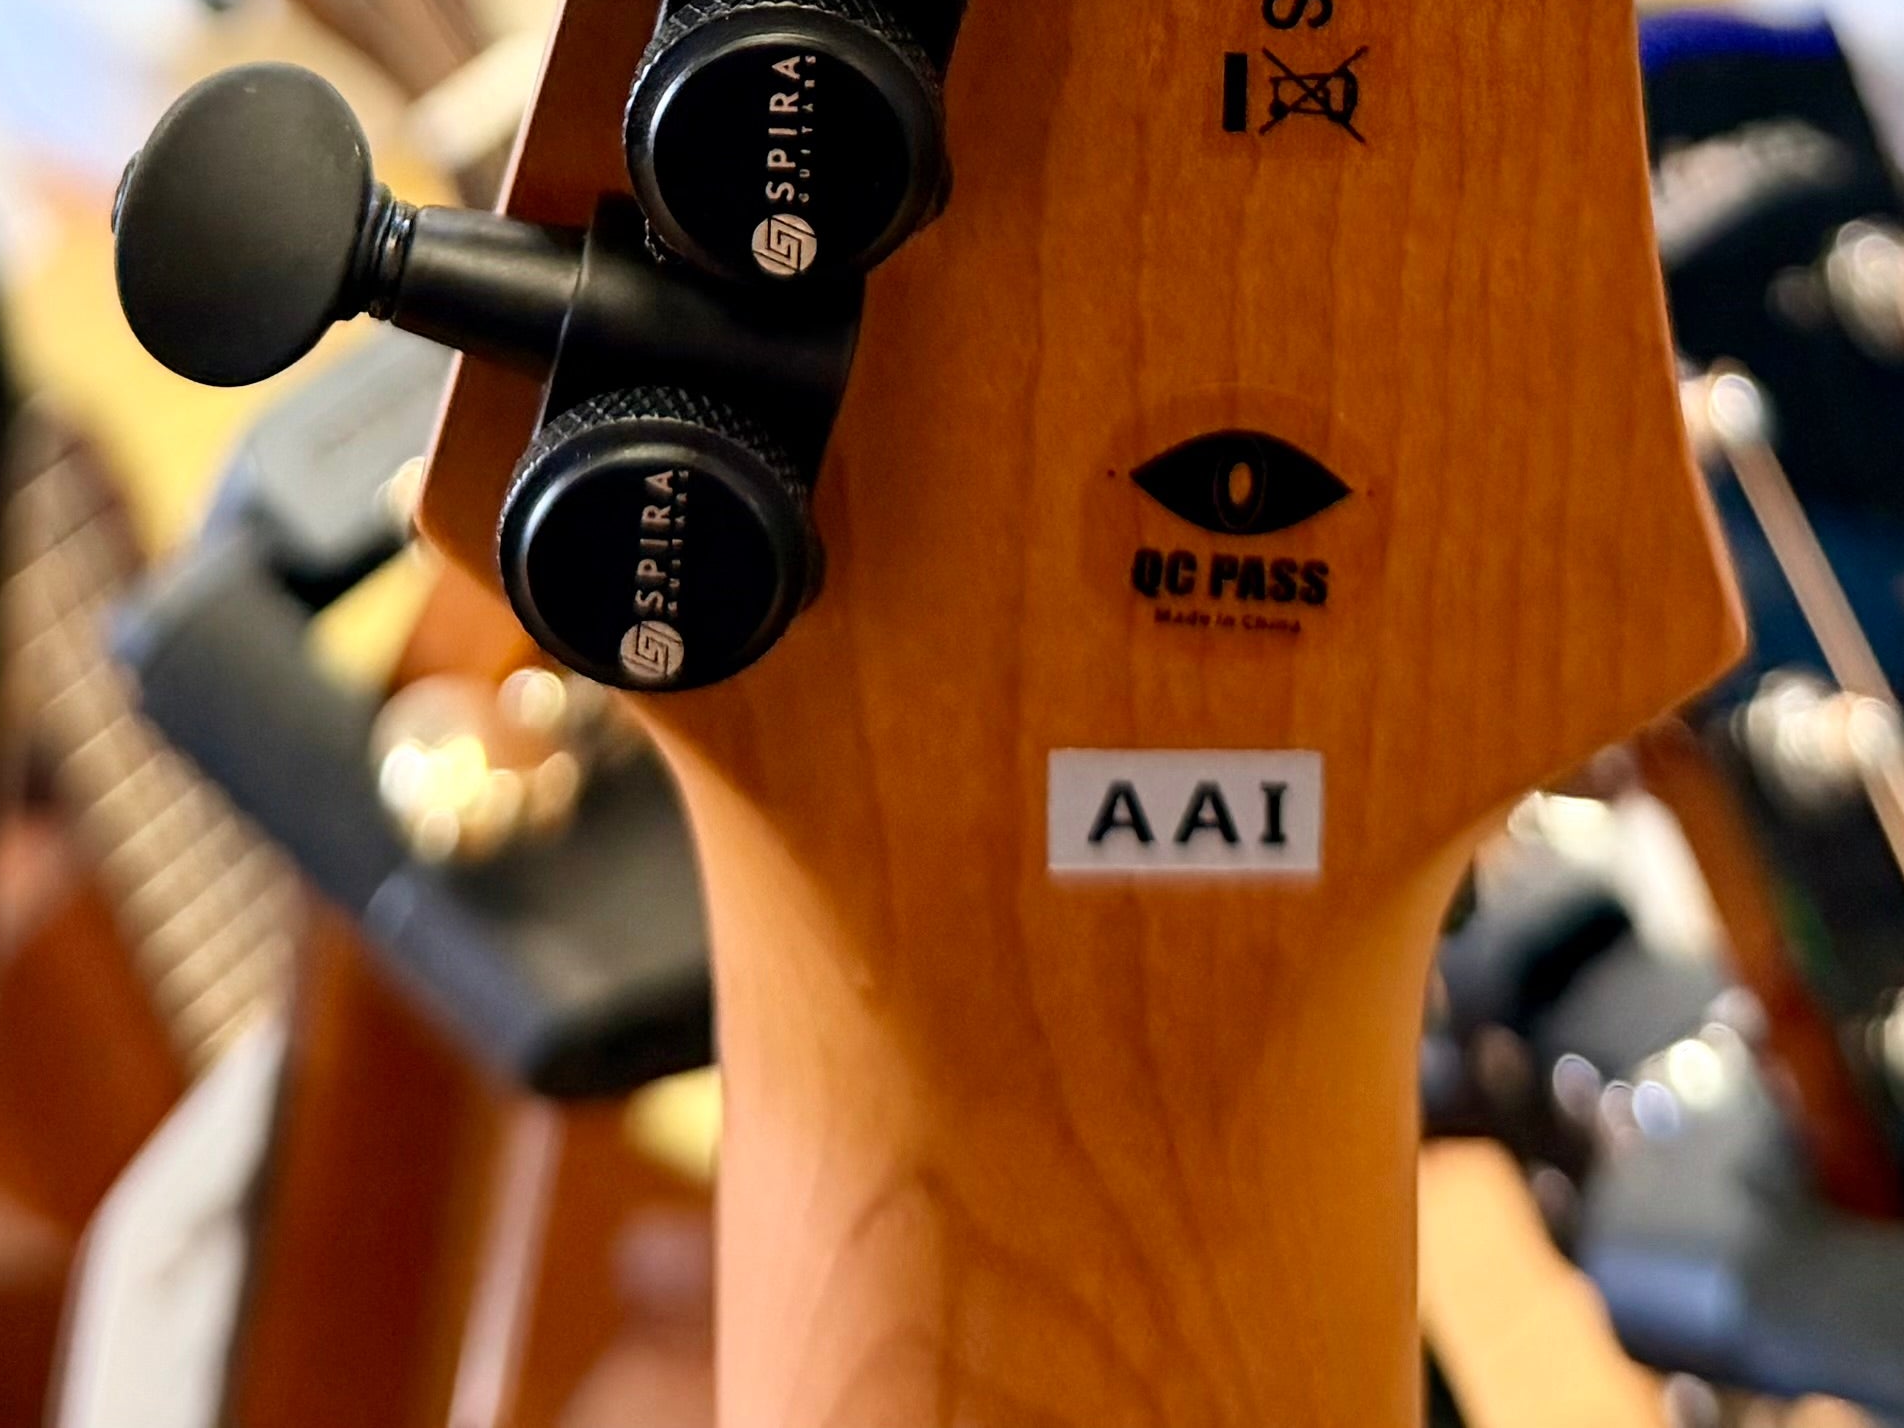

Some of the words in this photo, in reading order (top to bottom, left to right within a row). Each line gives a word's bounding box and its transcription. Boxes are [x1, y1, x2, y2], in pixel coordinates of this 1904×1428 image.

[765, 55, 801, 203] SPIRA
[634, 469, 675, 616] SPIRA
[1131, 548, 1196, 598] QC
[1209, 553, 1329, 606] PASS
[1087, 780, 1289, 847] AAI
